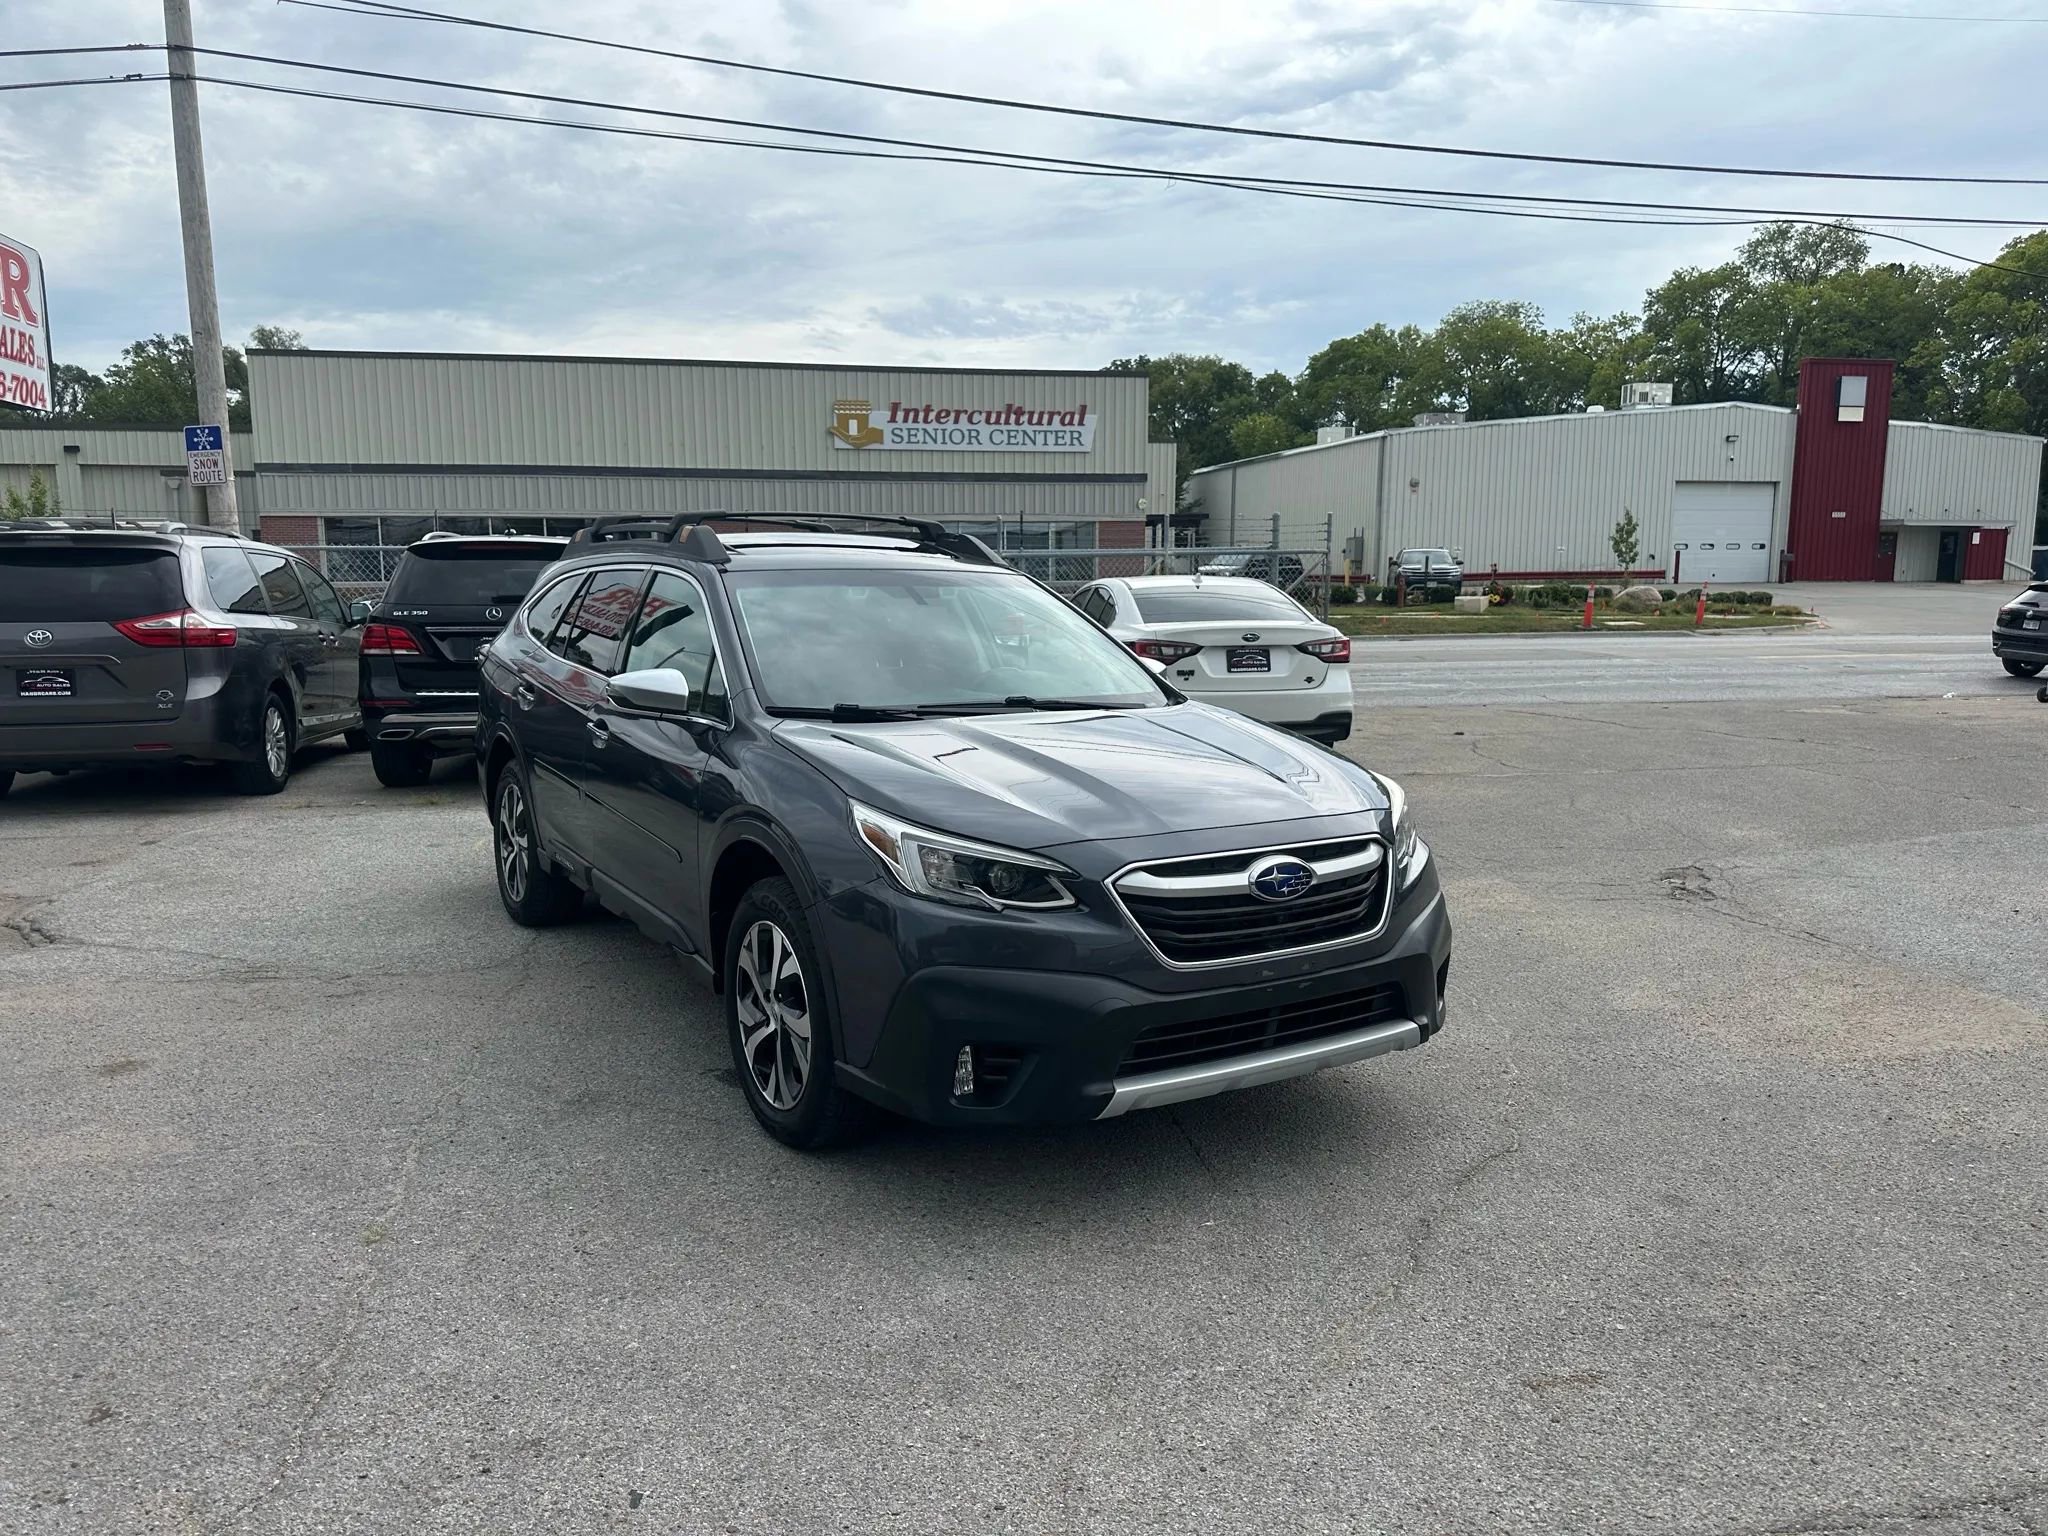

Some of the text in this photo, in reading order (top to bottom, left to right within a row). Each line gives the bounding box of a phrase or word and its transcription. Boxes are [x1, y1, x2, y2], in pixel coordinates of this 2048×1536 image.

[887, 402, 1088, 426] Intercultural
[891, 427, 1085, 447] SENIOR CENTER
[193, 458, 219, 470] SNOW
[193, 470, 223, 482] ROUTE
